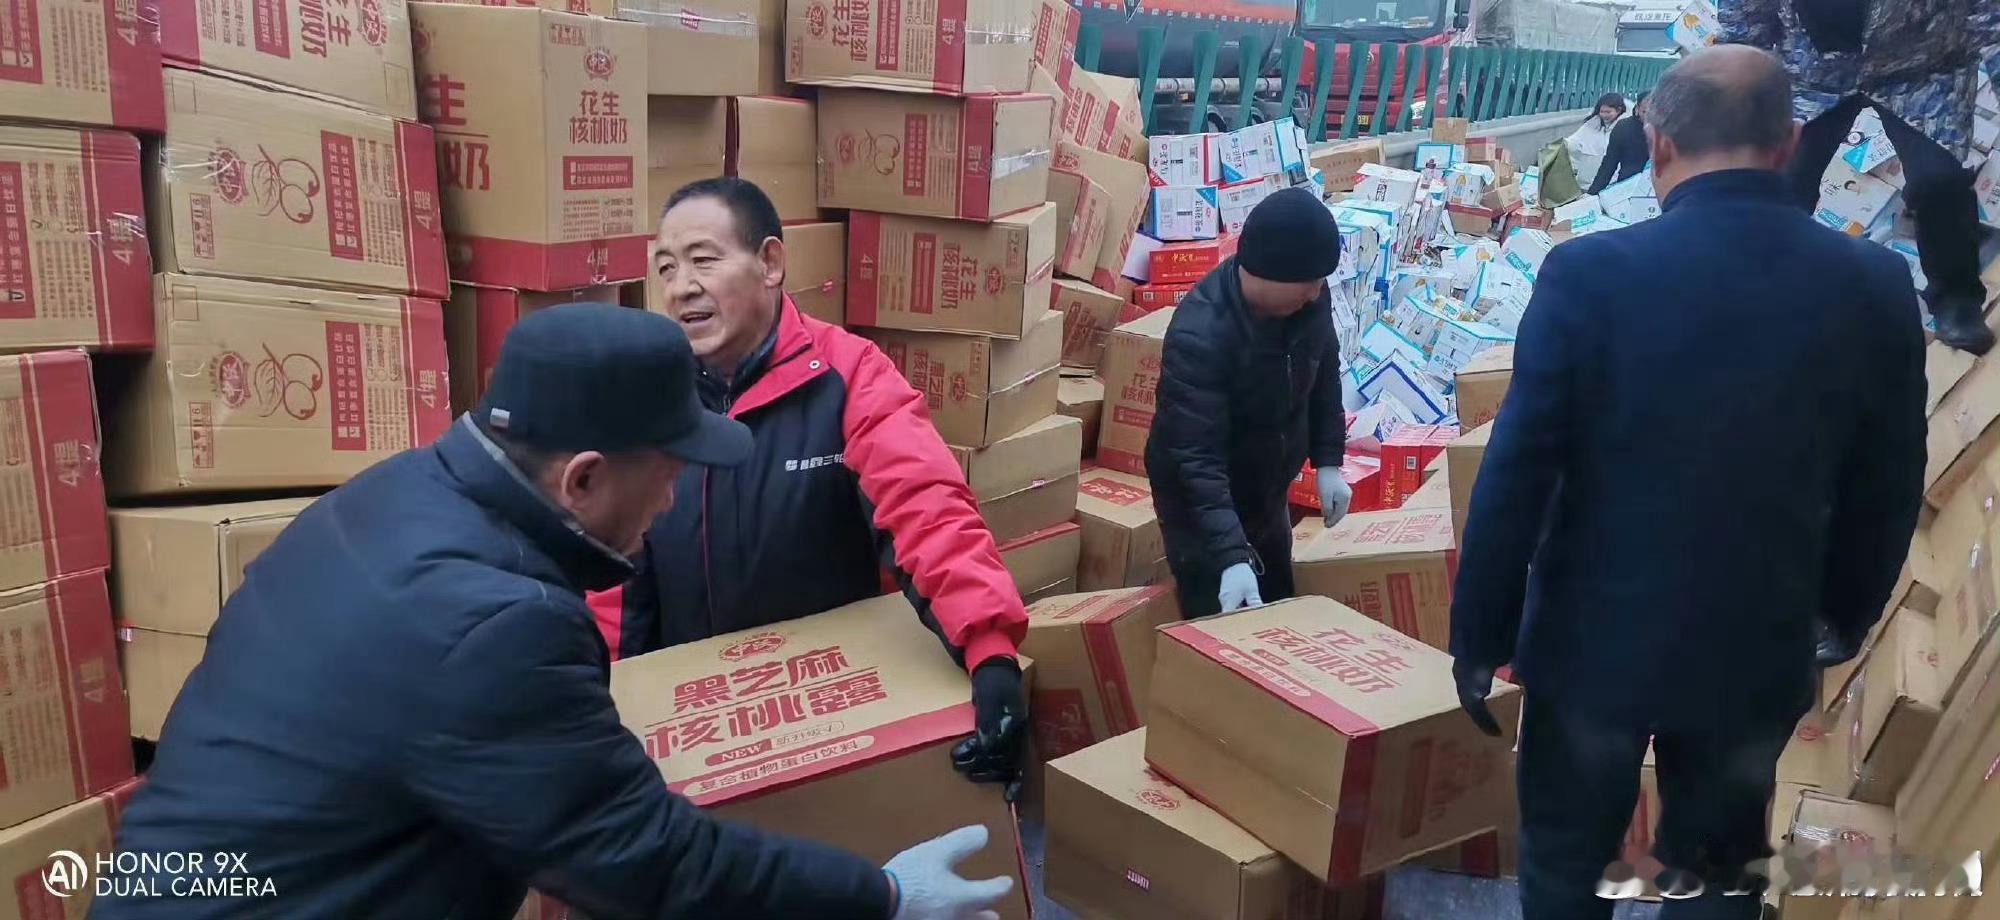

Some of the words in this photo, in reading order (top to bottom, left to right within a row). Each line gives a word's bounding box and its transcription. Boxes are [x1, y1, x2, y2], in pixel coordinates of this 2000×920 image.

[580, 90, 620, 117] 花生
[569, 117, 628, 145] 核桃奶
[413, 190, 433, 231] 4提
[941, 244, 961, 309] 核桃奶
[960, 256, 978, 301] 花生
[417, 369, 438, 409] 4提
[1251, 627, 1396, 693] 核桃奶
[1306, 627, 1416, 676] 花生
[672, 645, 849, 713] 黑芝麻
[645, 671, 888, 760] 核桃露
[698, 739, 859, 792] 复合植物蛋白饮料
[721, 742, 763, 762] NEW
